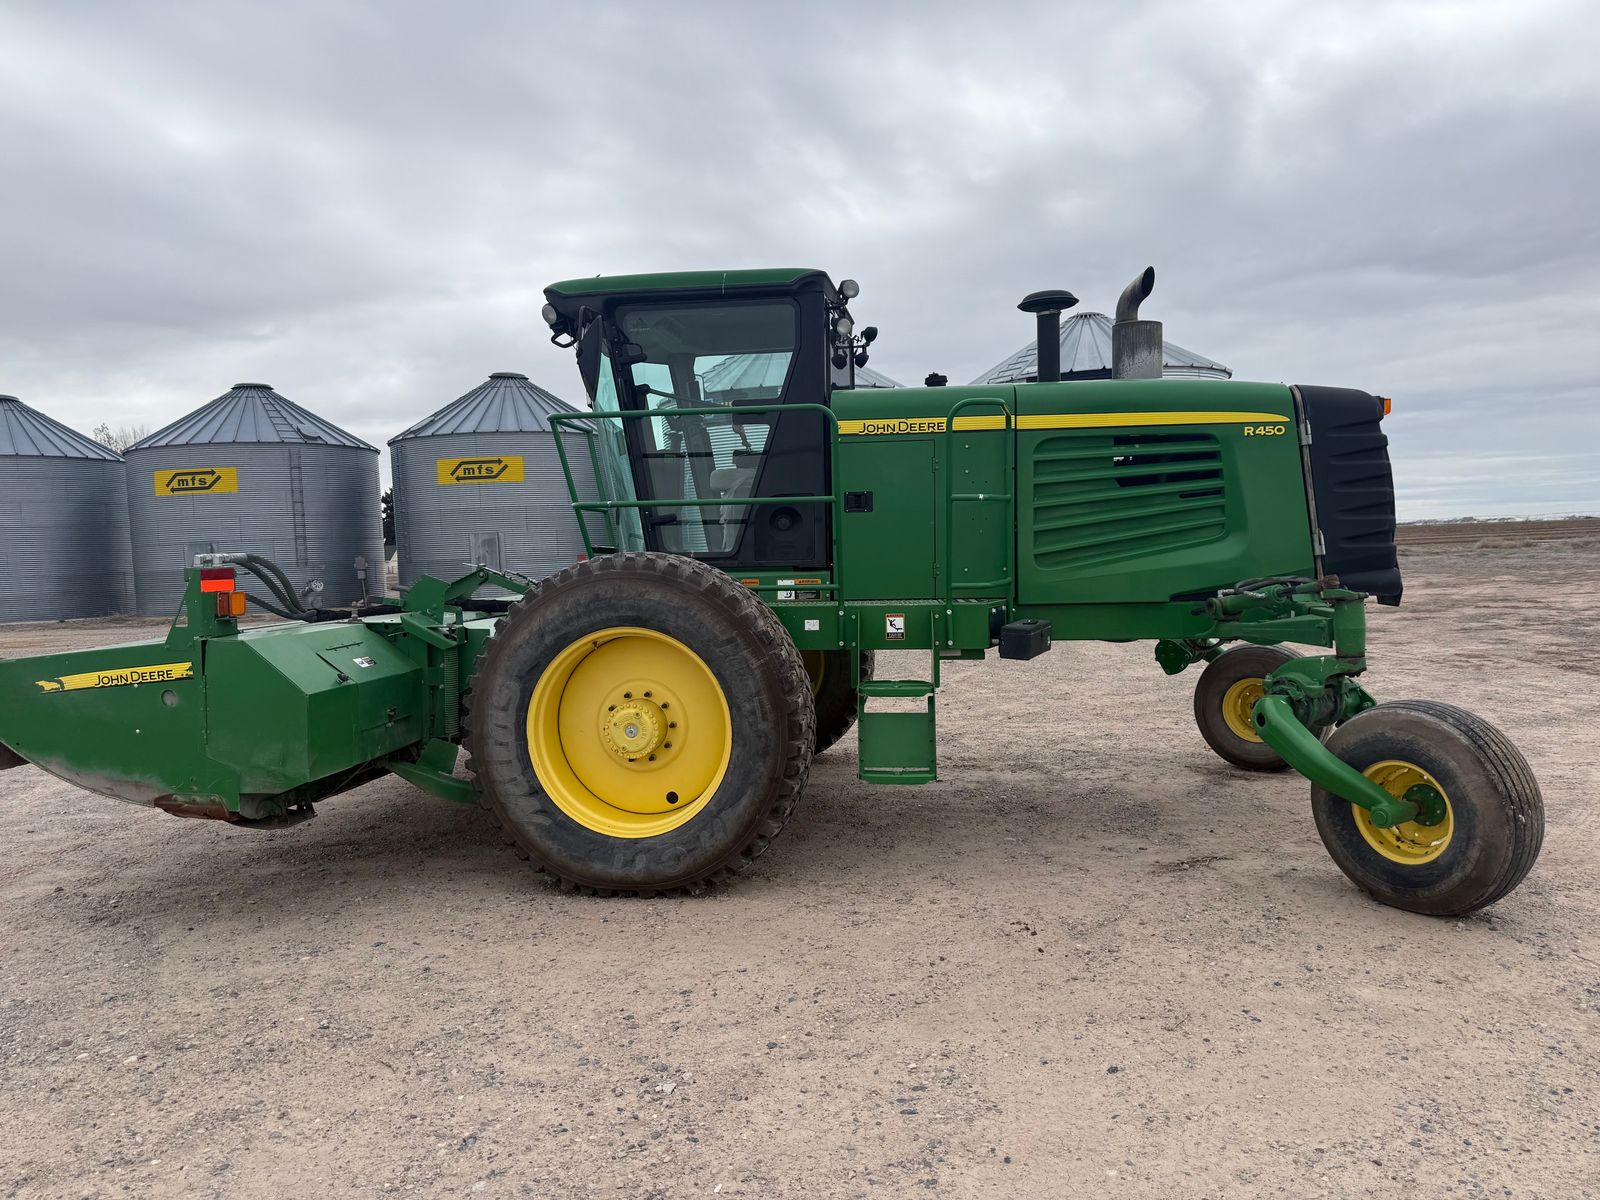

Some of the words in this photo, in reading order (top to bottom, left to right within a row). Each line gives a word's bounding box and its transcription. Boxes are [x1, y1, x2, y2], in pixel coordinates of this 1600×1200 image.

[858, 422, 896, 433] JOHN
[898, 421, 945, 432] DEERE
[1244, 425, 1286, 436] R450
[463, 464, 494, 476] mfs
[177, 475, 207, 487] mfs
[95, 673, 129, 686] JOHN
[130, 669, 174, 682] DEERE
